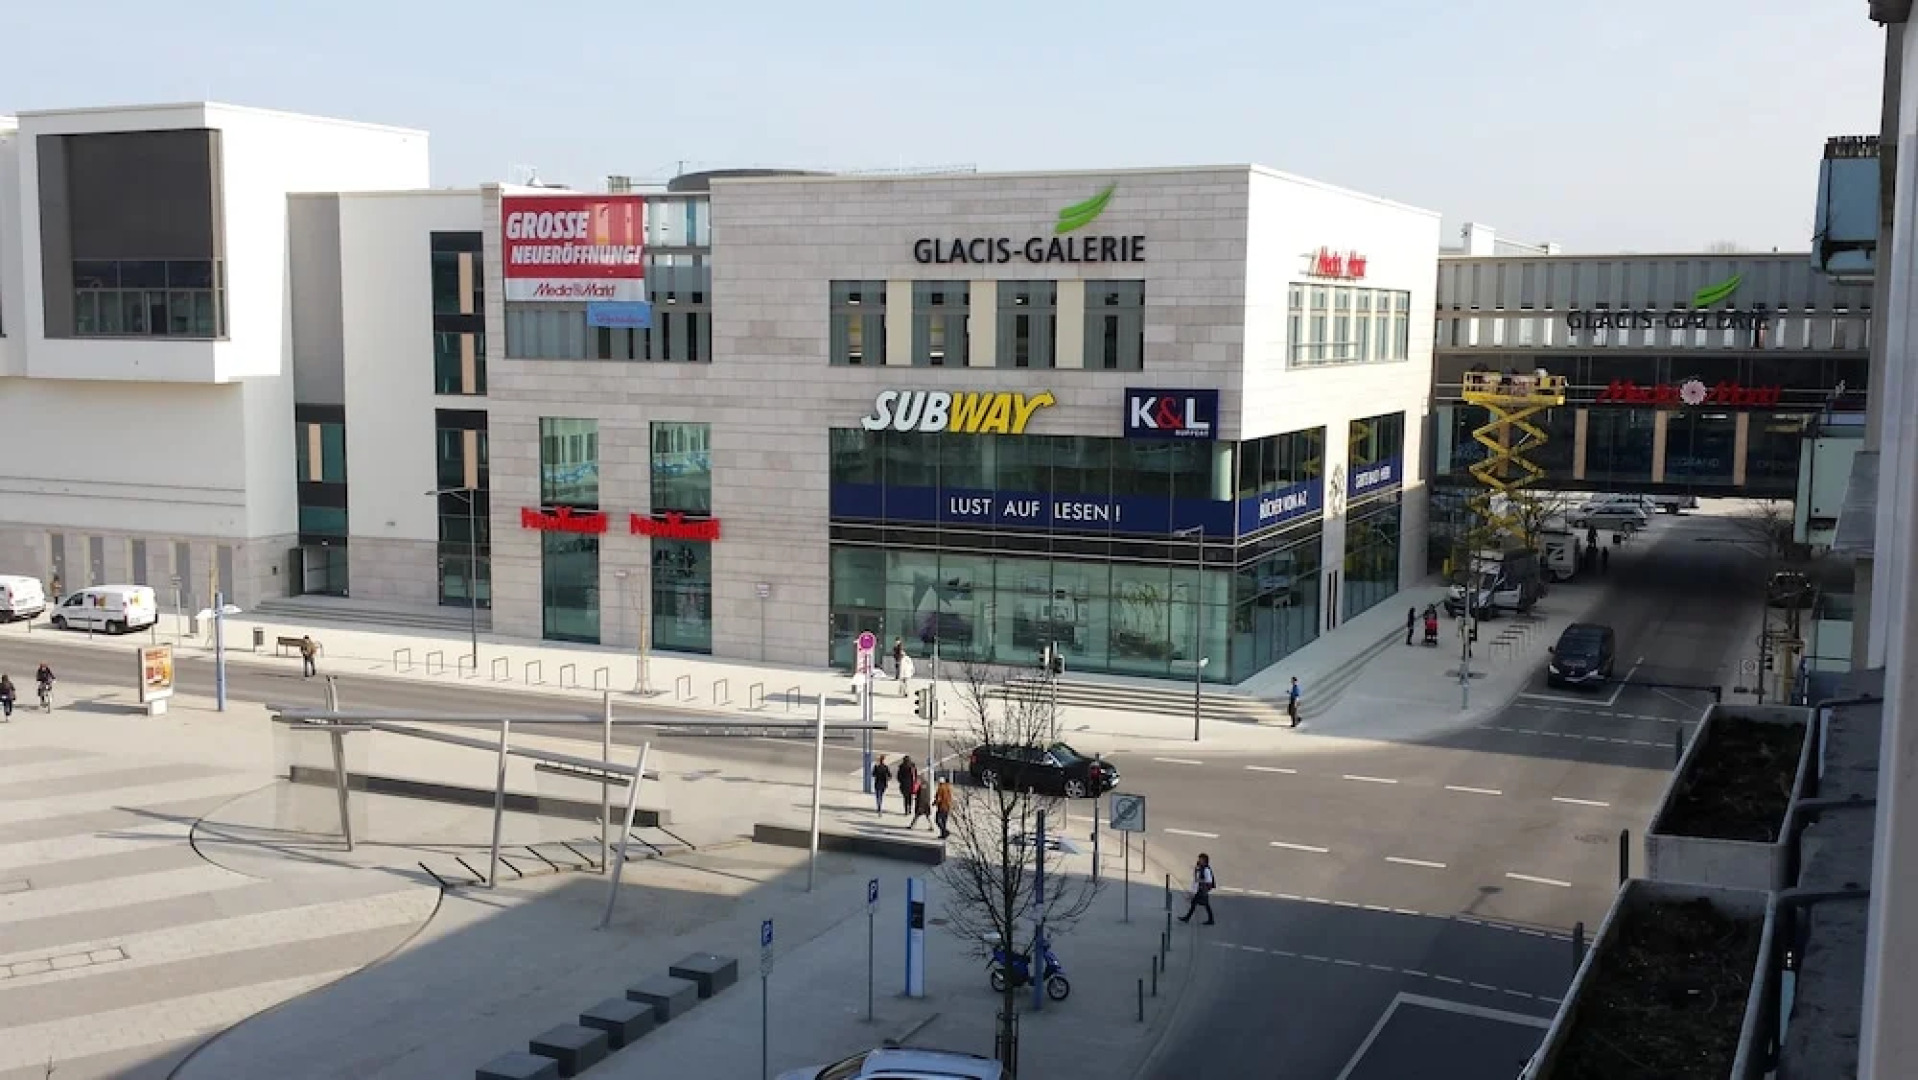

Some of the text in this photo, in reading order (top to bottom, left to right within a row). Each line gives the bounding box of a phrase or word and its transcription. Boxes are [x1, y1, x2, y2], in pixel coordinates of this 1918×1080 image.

[506, 210, 590, 239] GROSSE
[511, 242, 643, 265] NEUERÖFFNUNG!
[913, 234, 1146, 264] GLACIS-GALERIE
[1566, 310, 1770, 330] GLACIS-GALERIE
[861, 389, 1055, 434] SUBWAY
[1131, 396, 1210, 430] K&L
[950, 497, 992, 515] LUST
[1003, 500, 1041, 517] AUF
